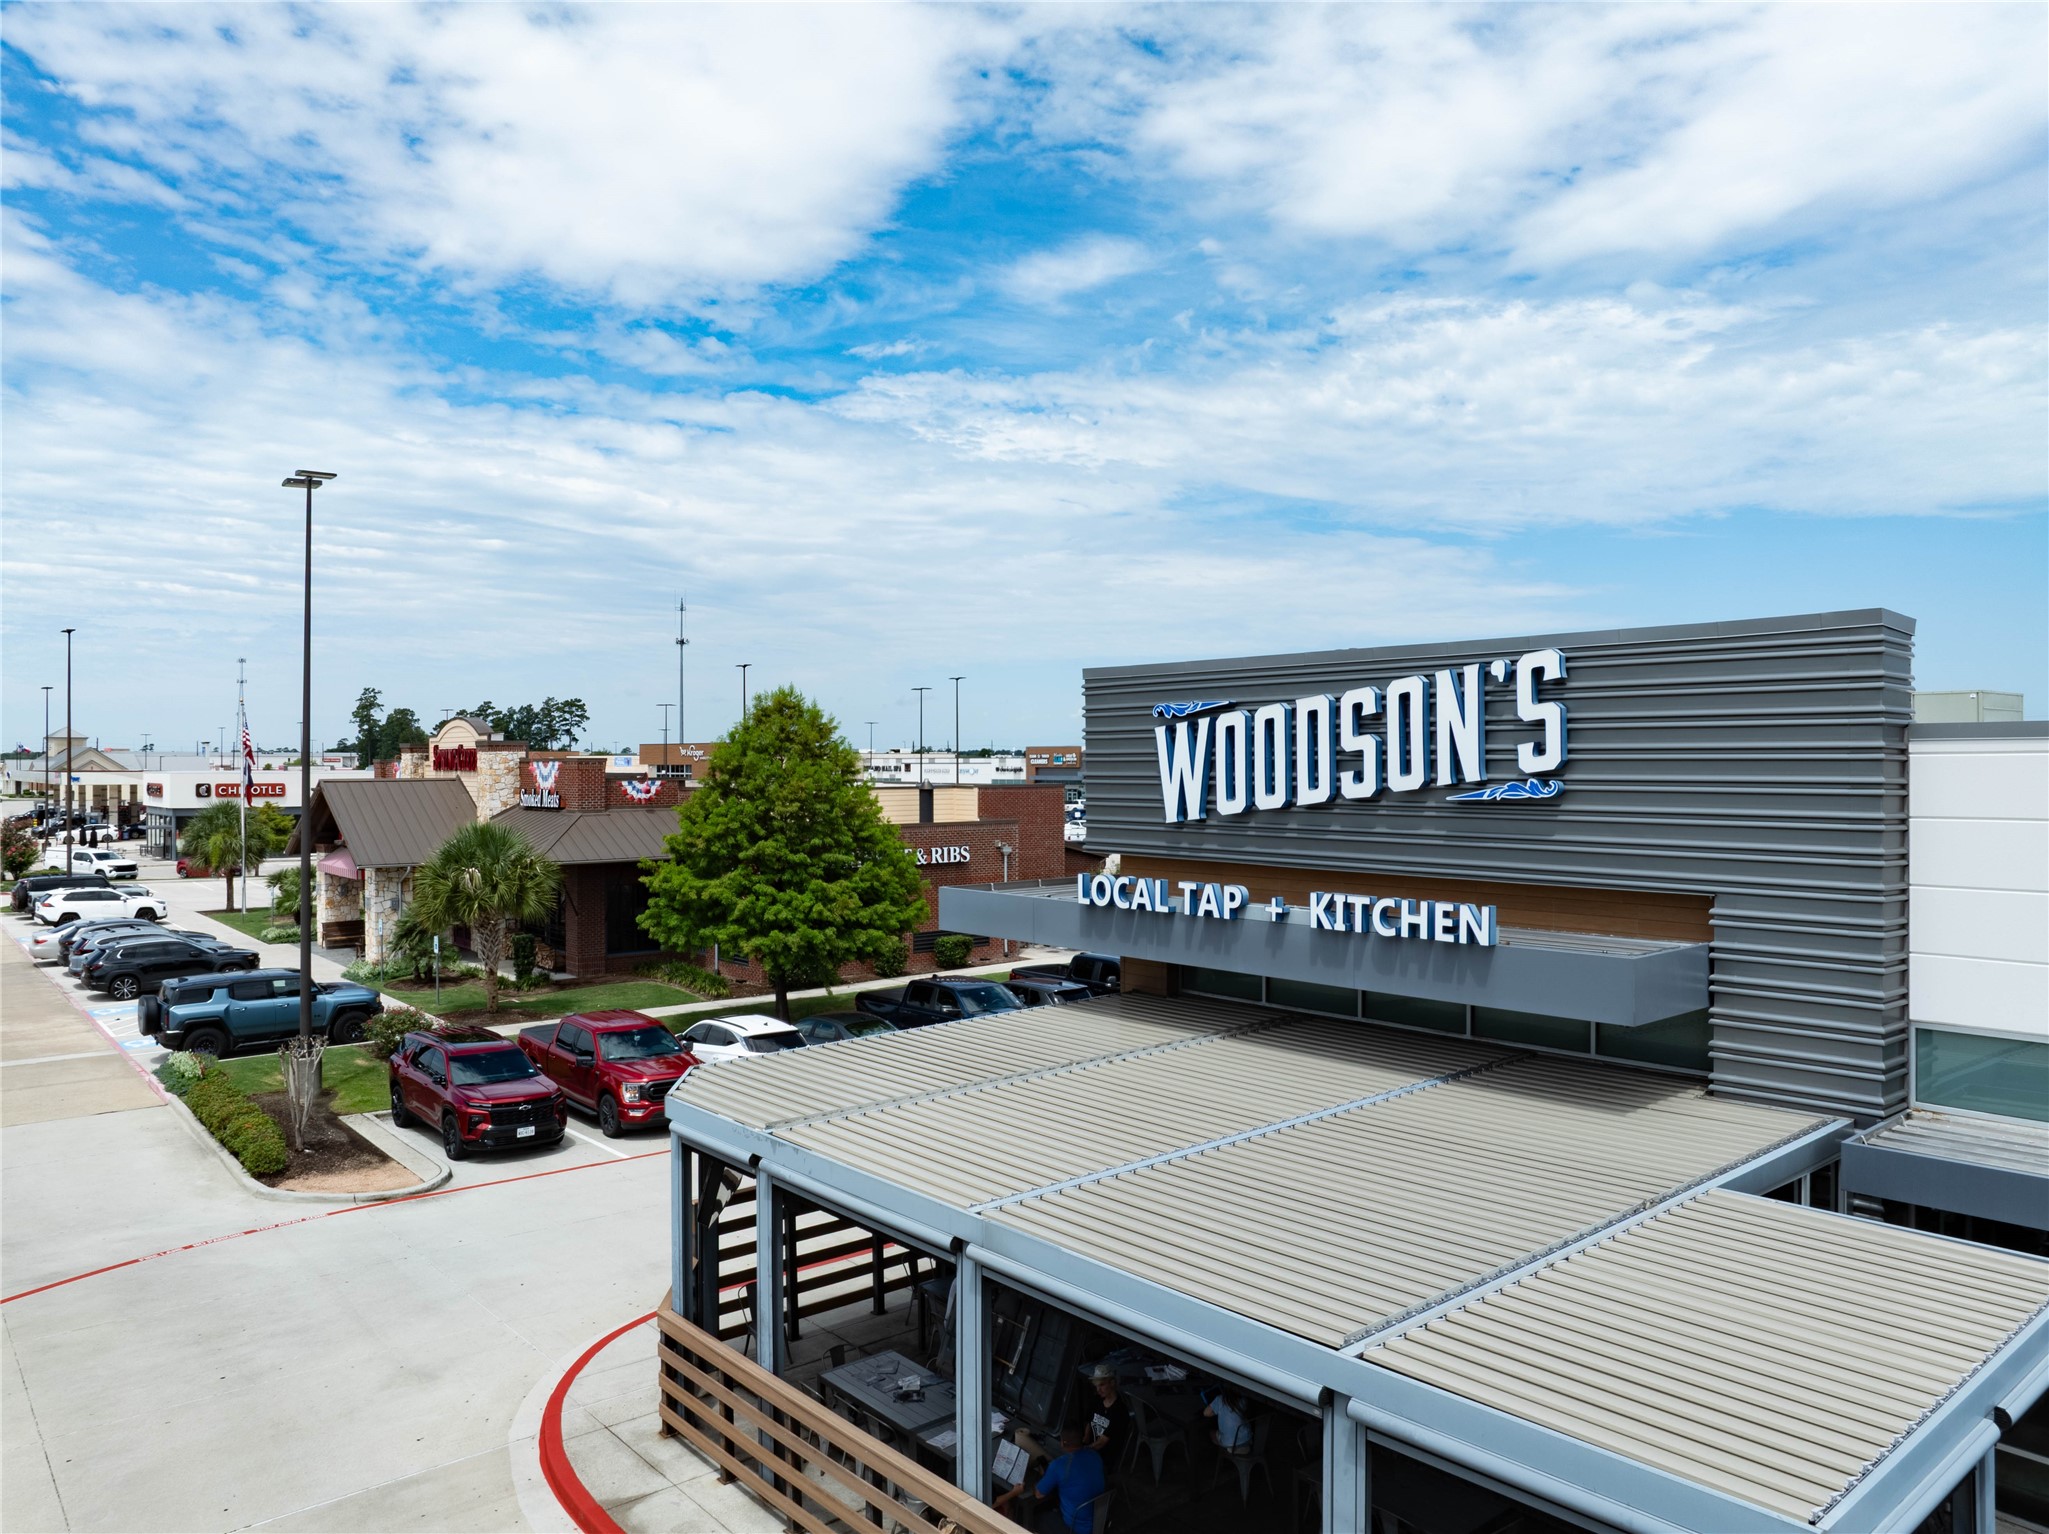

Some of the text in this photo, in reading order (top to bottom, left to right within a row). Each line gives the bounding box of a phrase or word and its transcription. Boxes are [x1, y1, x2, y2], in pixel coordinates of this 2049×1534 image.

[1154, 648, 1567, 824] WOODSON'S
[218, 785, 283, 796] CHIOTLE
[520, 788, 541, 807] Smoked
[916, 848, 927, 865] &
[931, 846, 970, 864] RIBS
[1077, 872, 1497, 947] LOCAL TAP + KITCHEN
